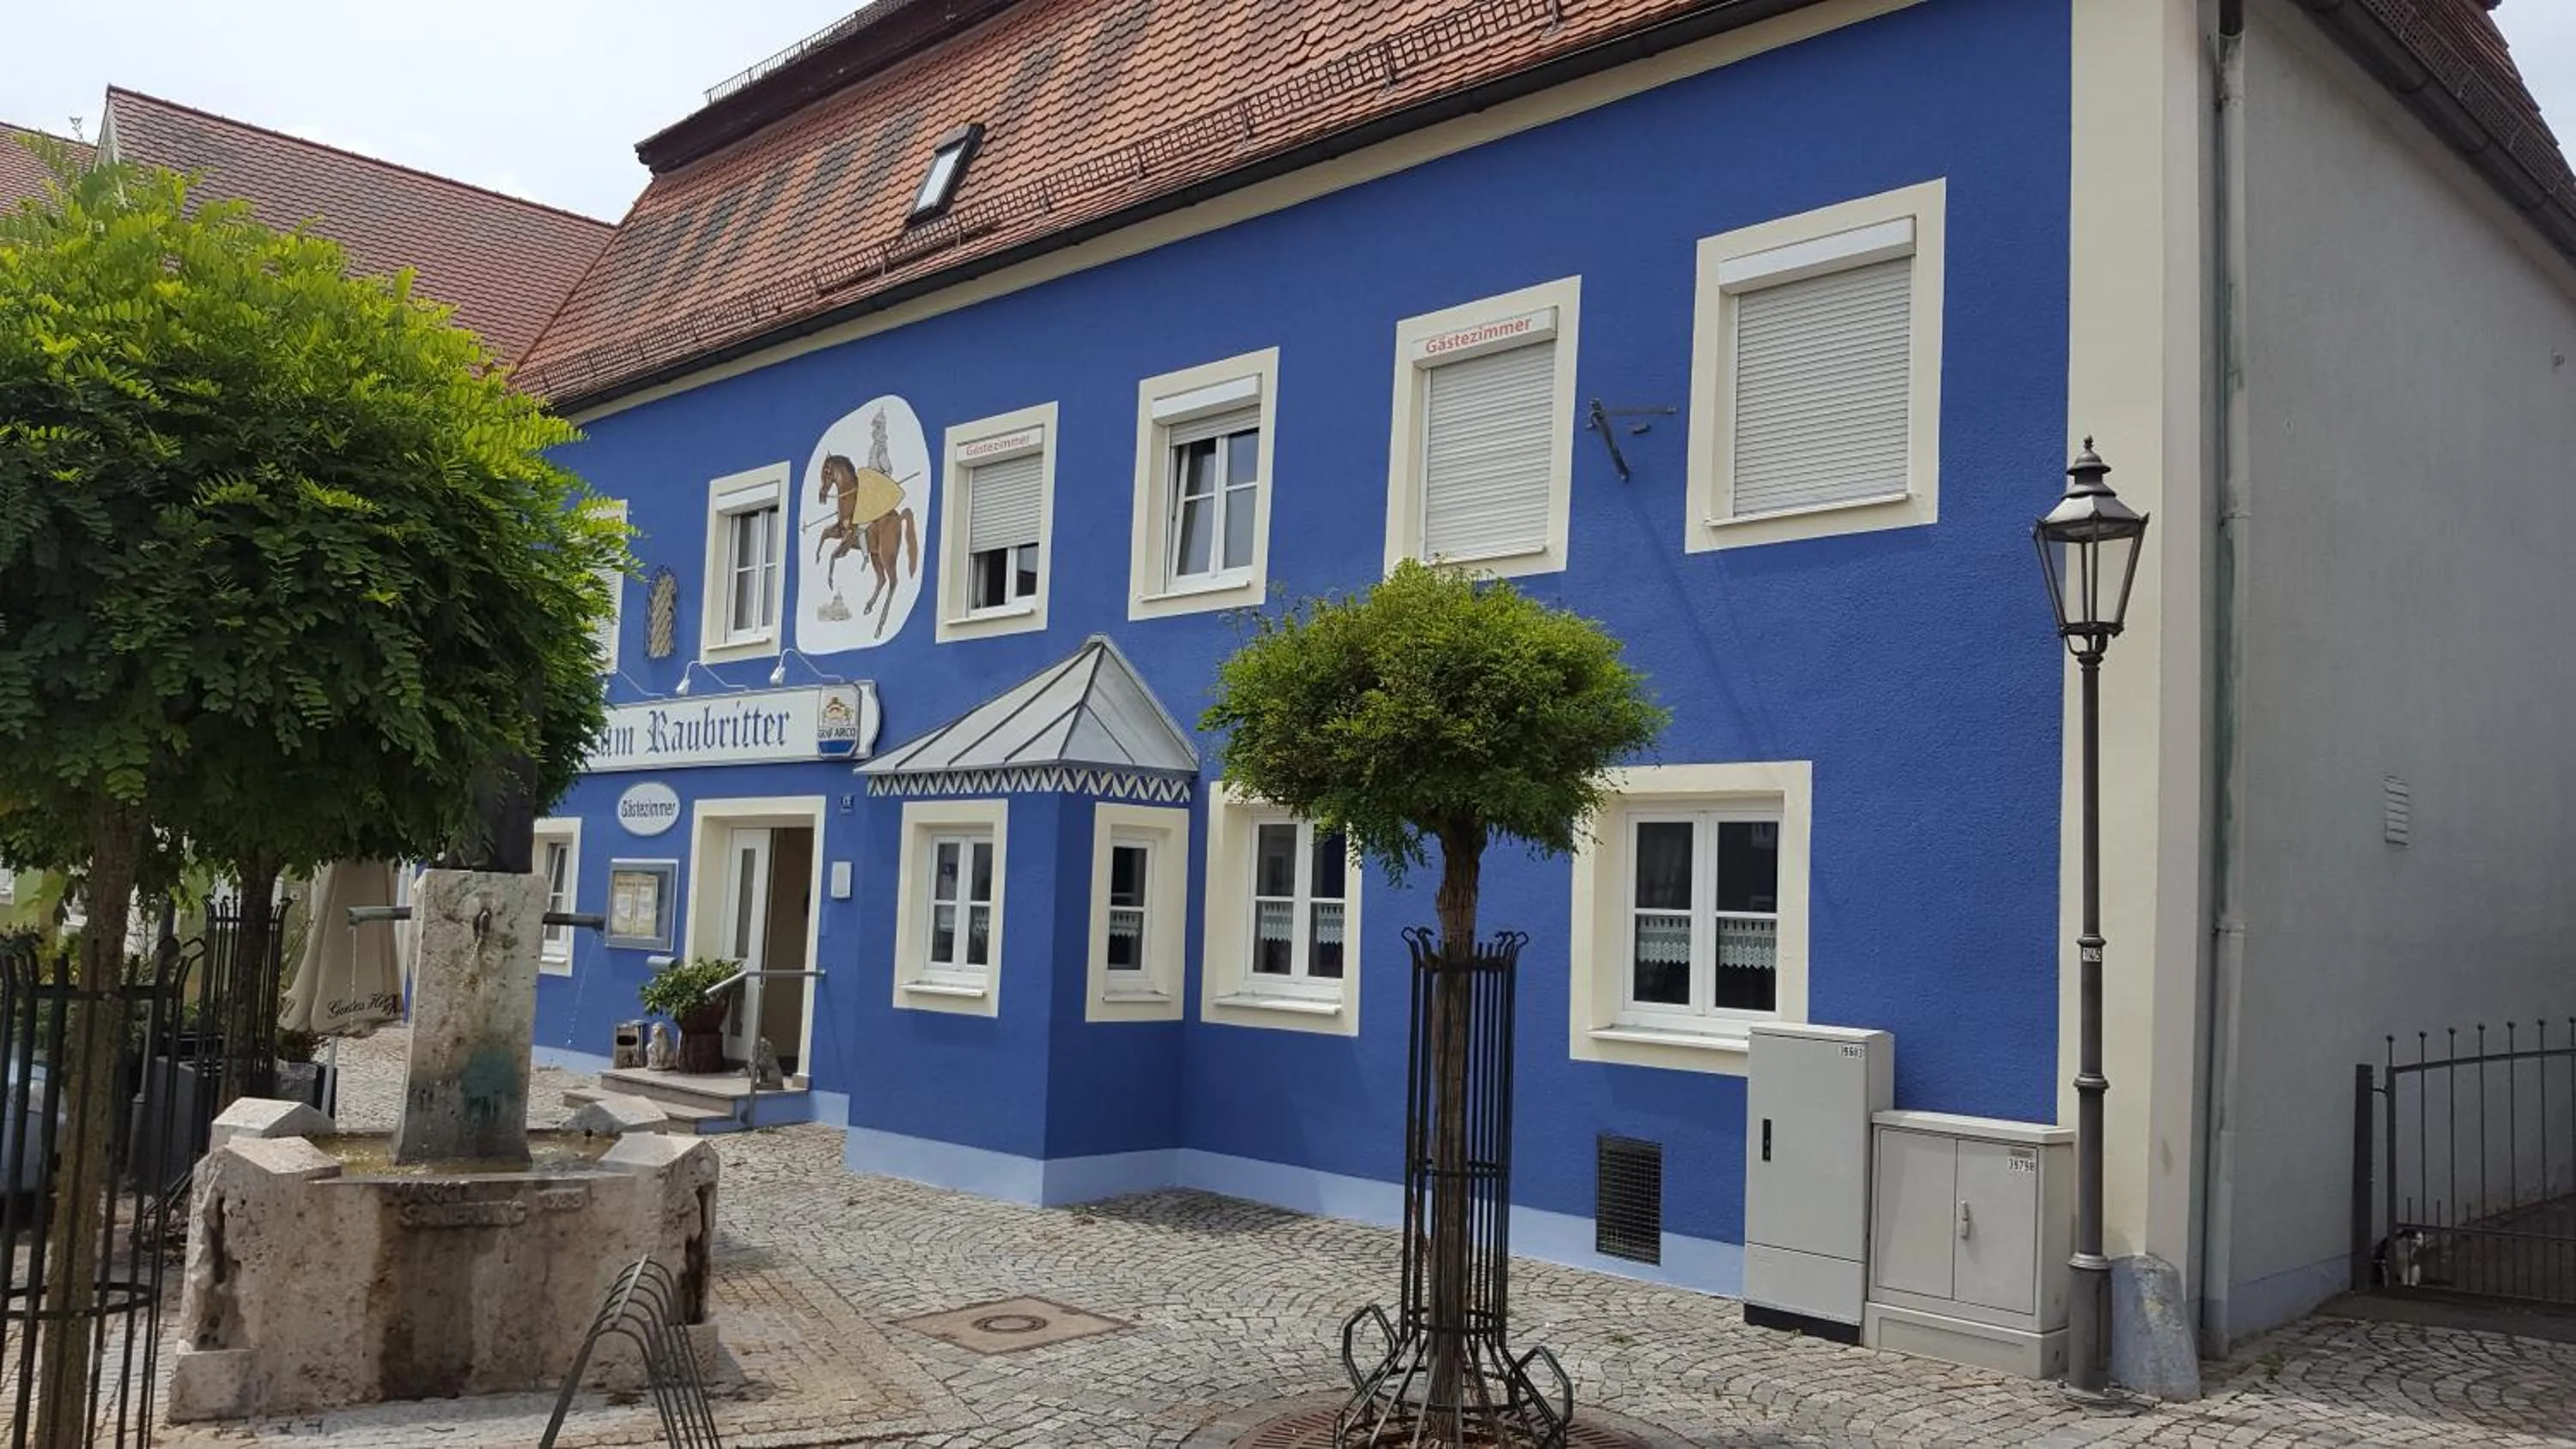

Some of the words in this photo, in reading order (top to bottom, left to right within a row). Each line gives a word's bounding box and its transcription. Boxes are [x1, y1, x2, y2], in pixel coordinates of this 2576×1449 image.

[1425, 318, 1533, 354] Gästezimmer
[966, 433, 1030, 456] Gästezimmer
[594, 726, 635, 757] um
[646, 700, 791, 755] Raubritter
[621, 798, 677, 818] Gästezimmer
